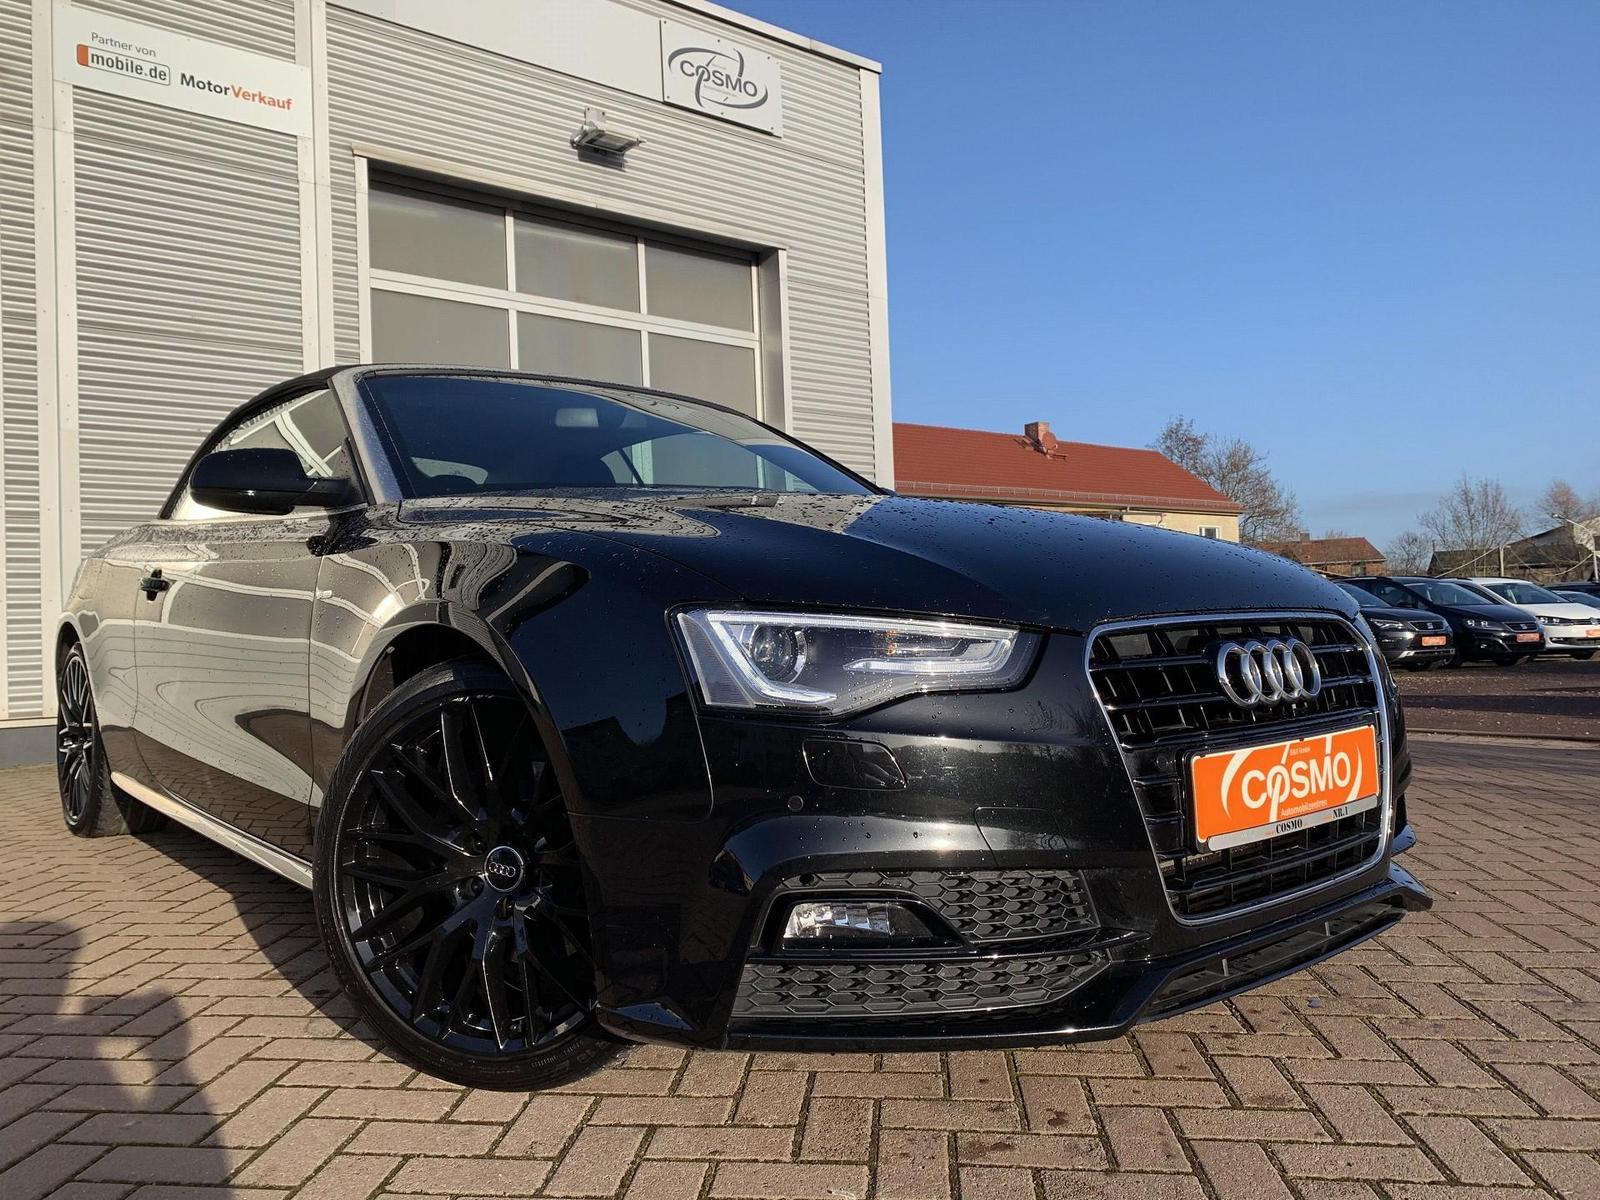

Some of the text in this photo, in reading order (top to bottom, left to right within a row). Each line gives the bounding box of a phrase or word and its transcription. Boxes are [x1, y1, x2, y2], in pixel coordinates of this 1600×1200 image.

[90, 32, 157, 58] Partner von
[90, 51, 293, 111] mobile.de MotorVerkauf
[680, 60, 758, 97] COSMO
[1241, 751, 1351, 809] COSMO
[1275, 818, 1303, 834] COSMO
